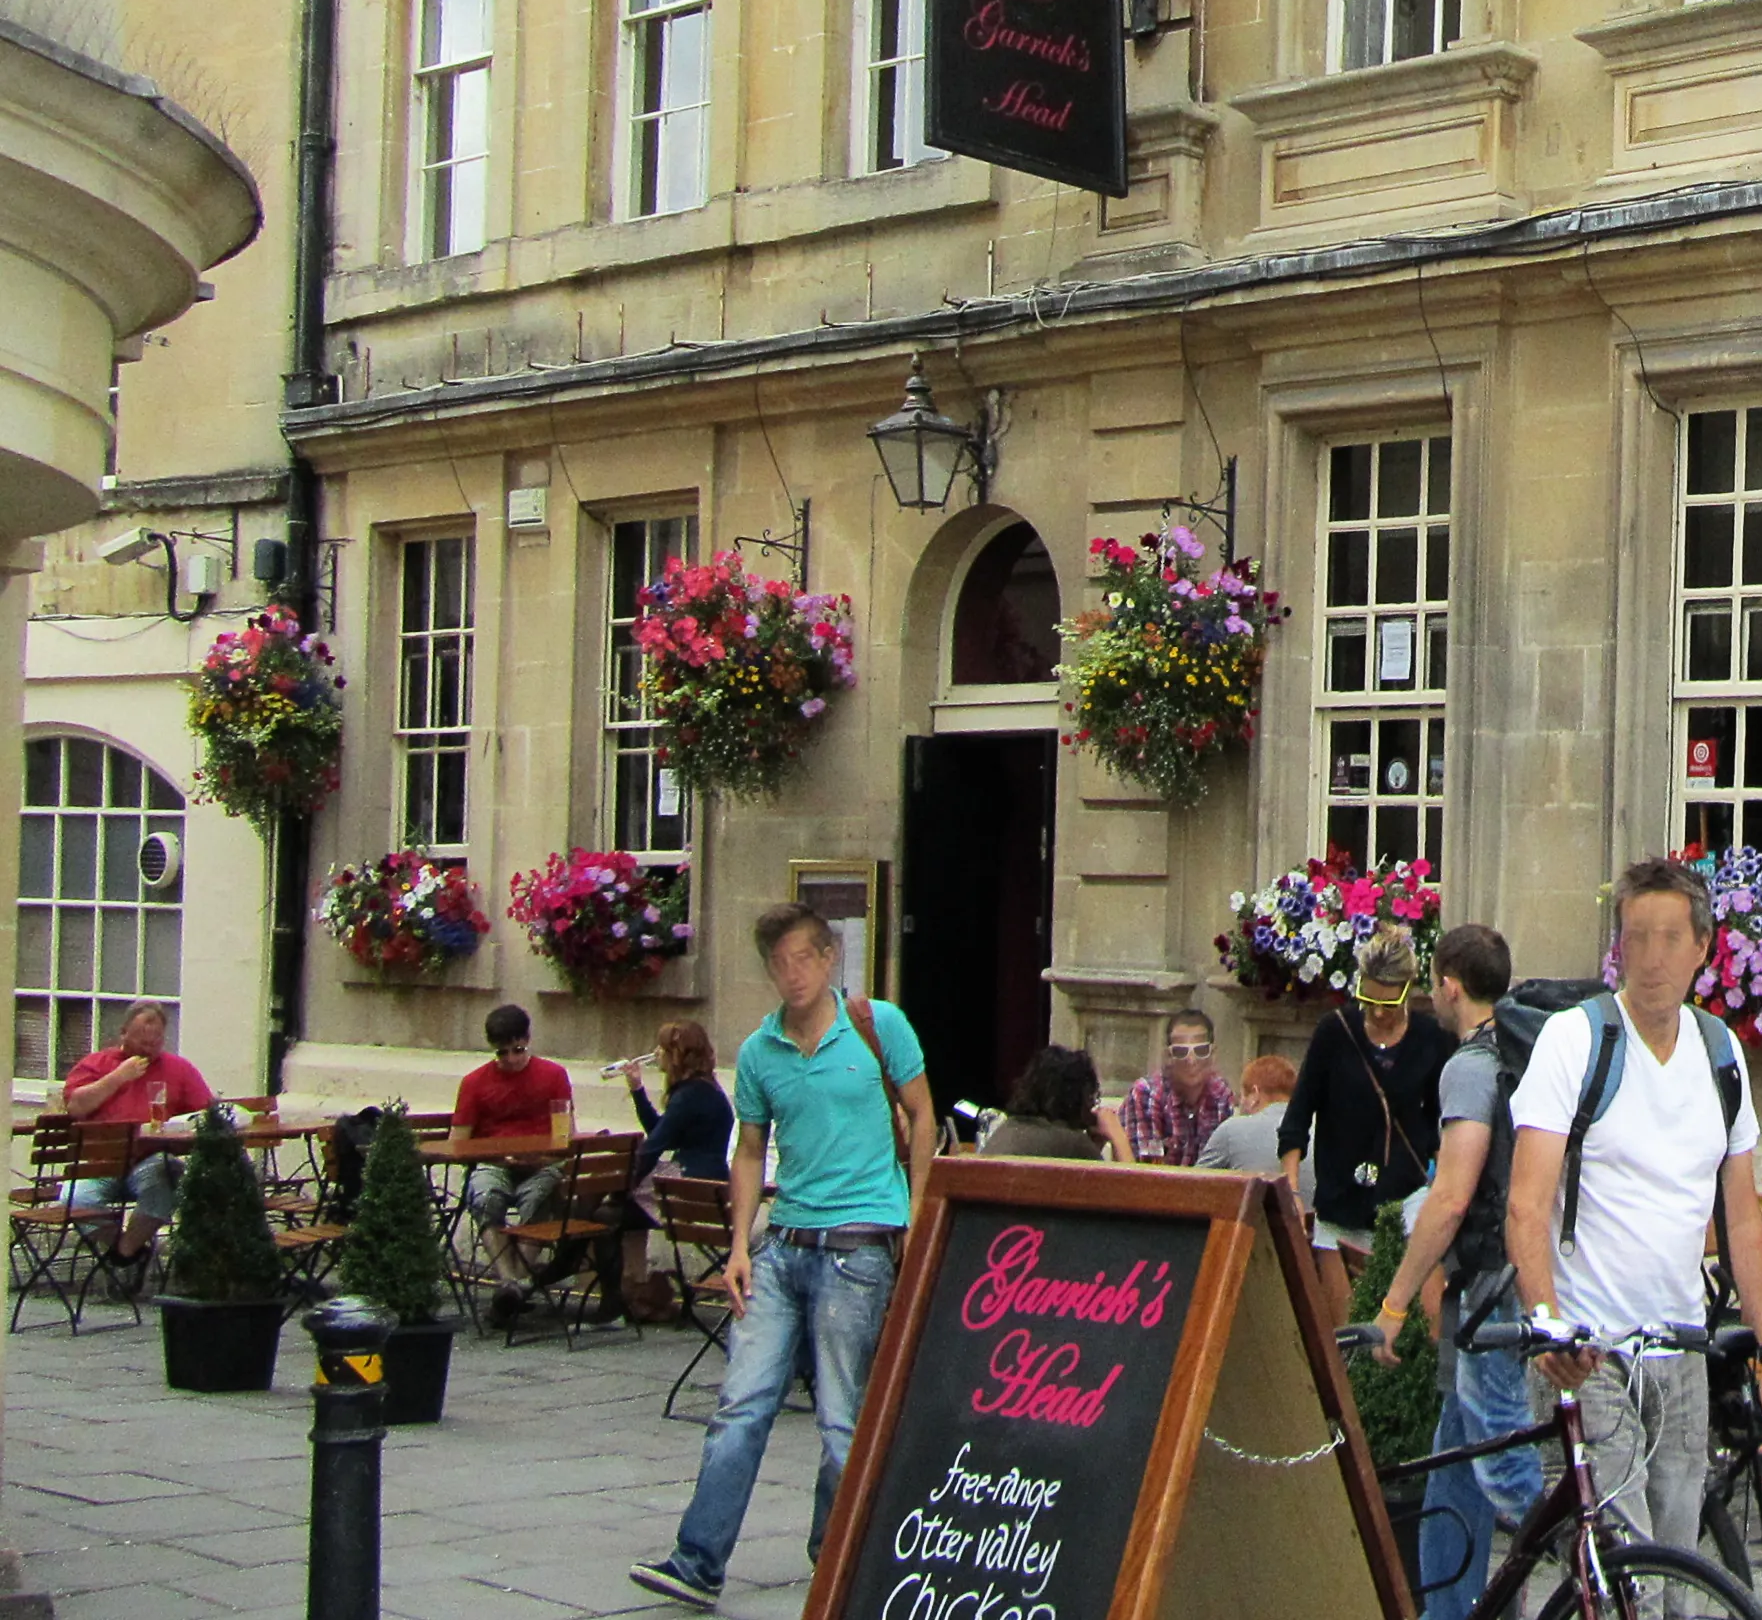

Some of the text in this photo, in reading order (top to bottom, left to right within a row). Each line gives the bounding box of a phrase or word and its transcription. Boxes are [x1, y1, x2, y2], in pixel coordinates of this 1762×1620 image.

[982, 79, 1073, 131] Head
[961, 1225, 1173, 1330] Garrick's
[971, 1328, 1125, 1428] Head
[929, 1441, 1062, 1526] free-range
[894, 1508, 974, 1563] Otter
